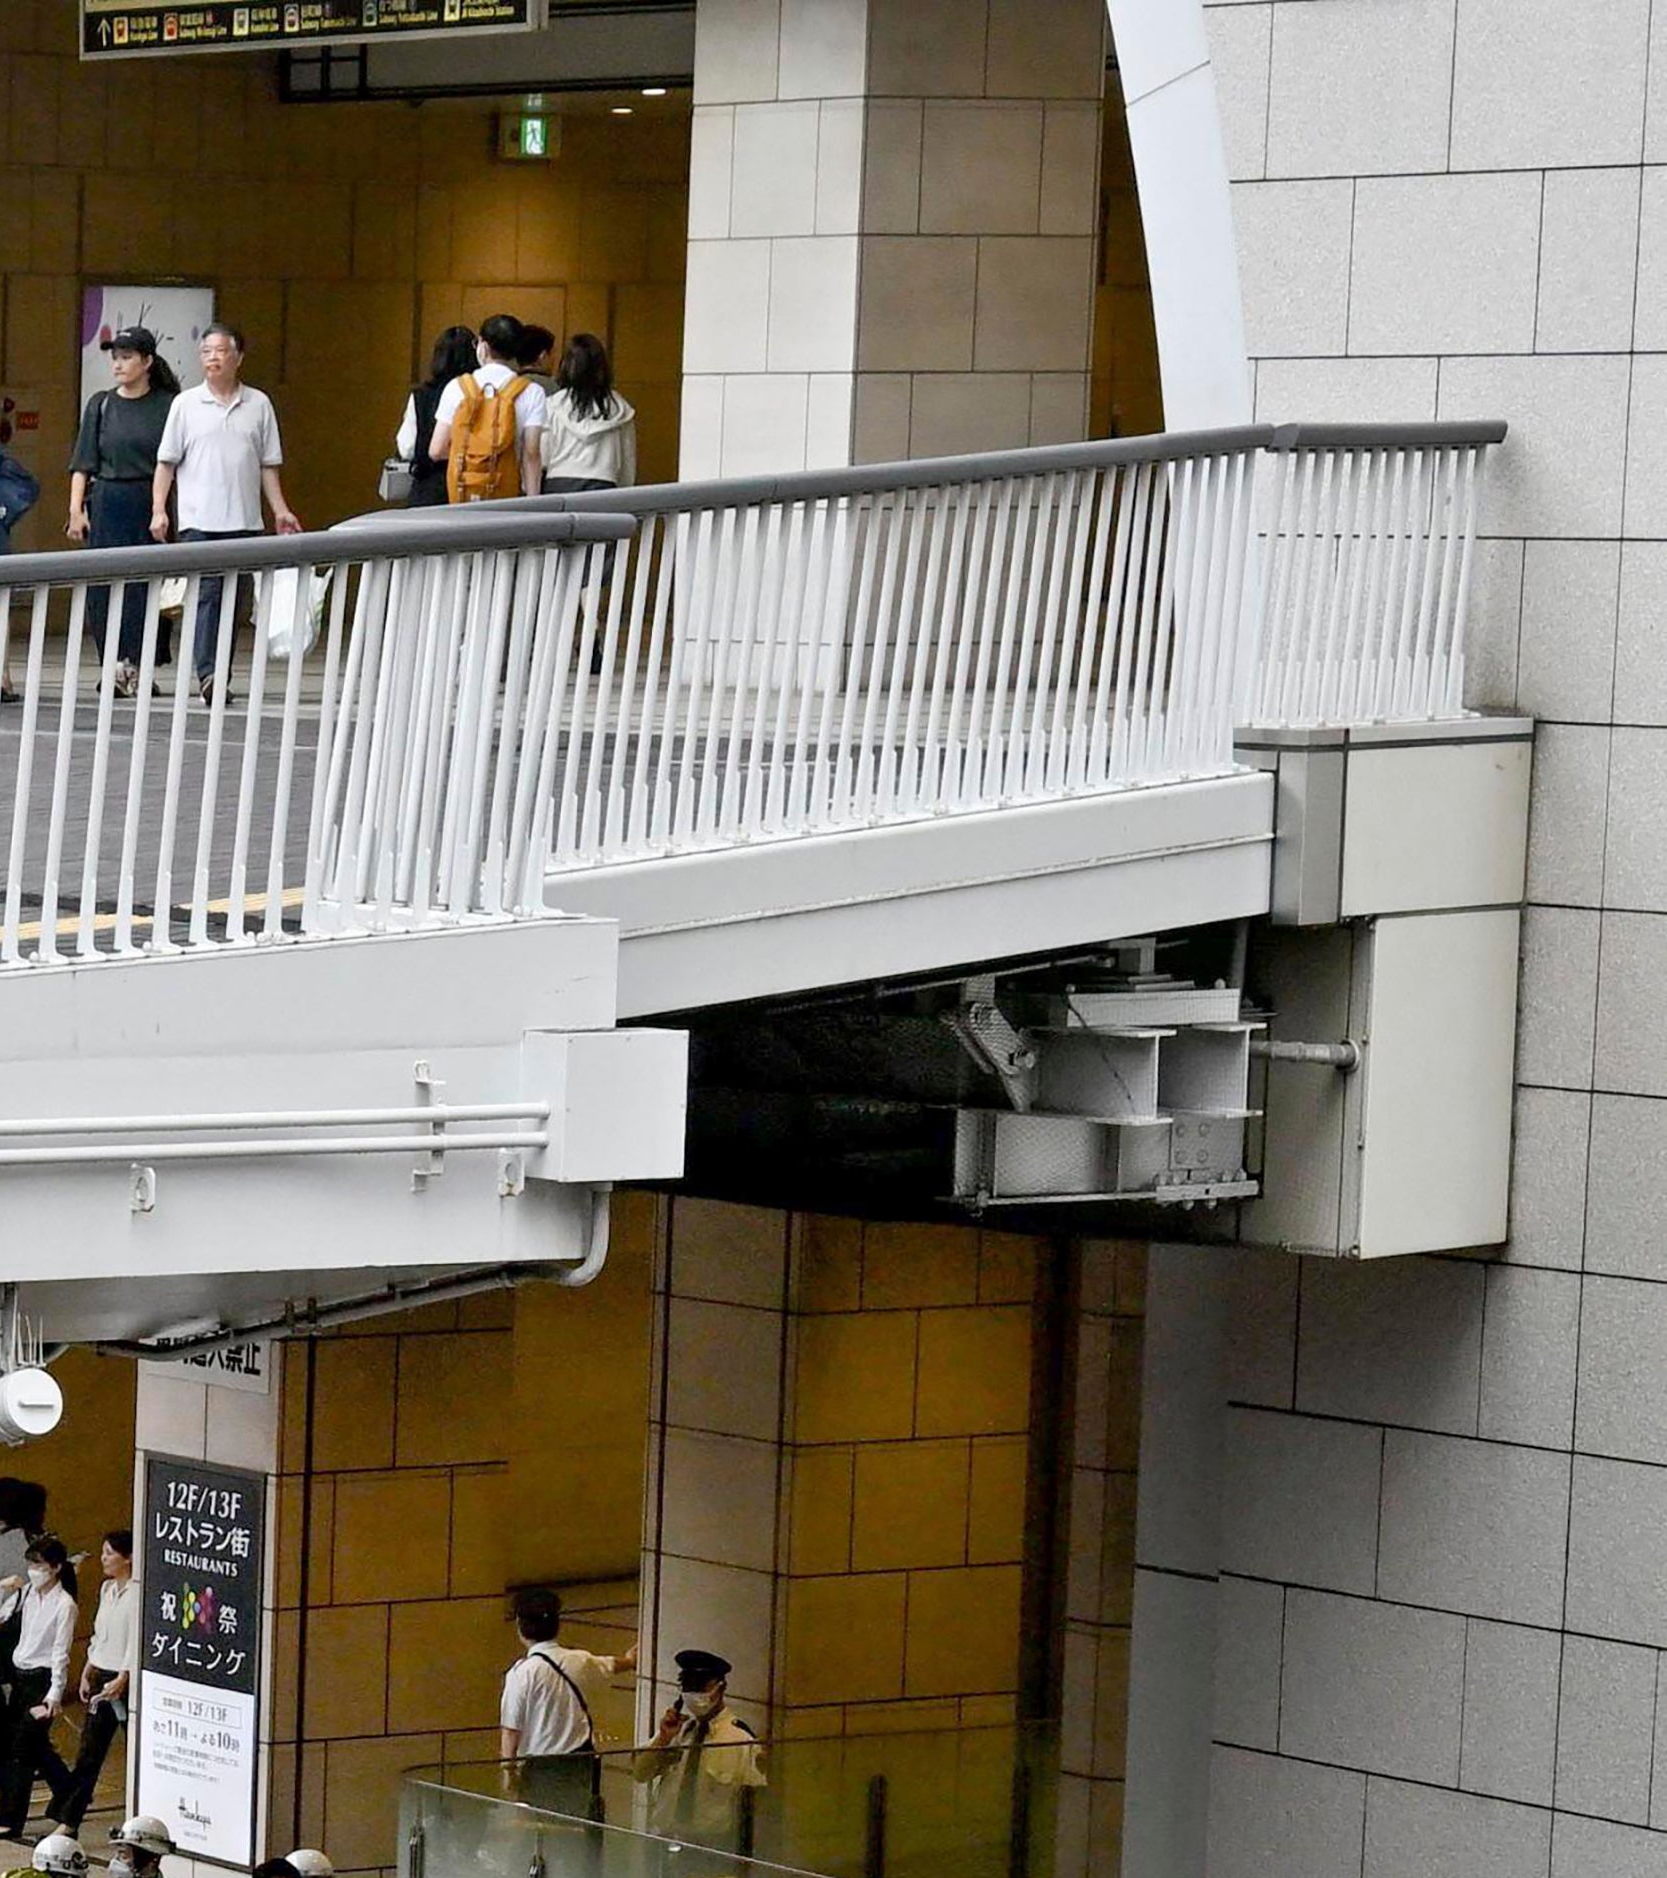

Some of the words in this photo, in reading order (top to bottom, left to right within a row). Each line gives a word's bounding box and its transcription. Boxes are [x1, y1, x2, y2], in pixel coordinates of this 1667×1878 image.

[168, 1481, 242, 1520] 12F/13F
[155, 1512, 250, 1558] レストラン街
[164, 1549, 238, 1577] RESTAURANTS
[218, 1604, 238, 1635] 祭
[151, 1631, 246, 1676] ダイニング
